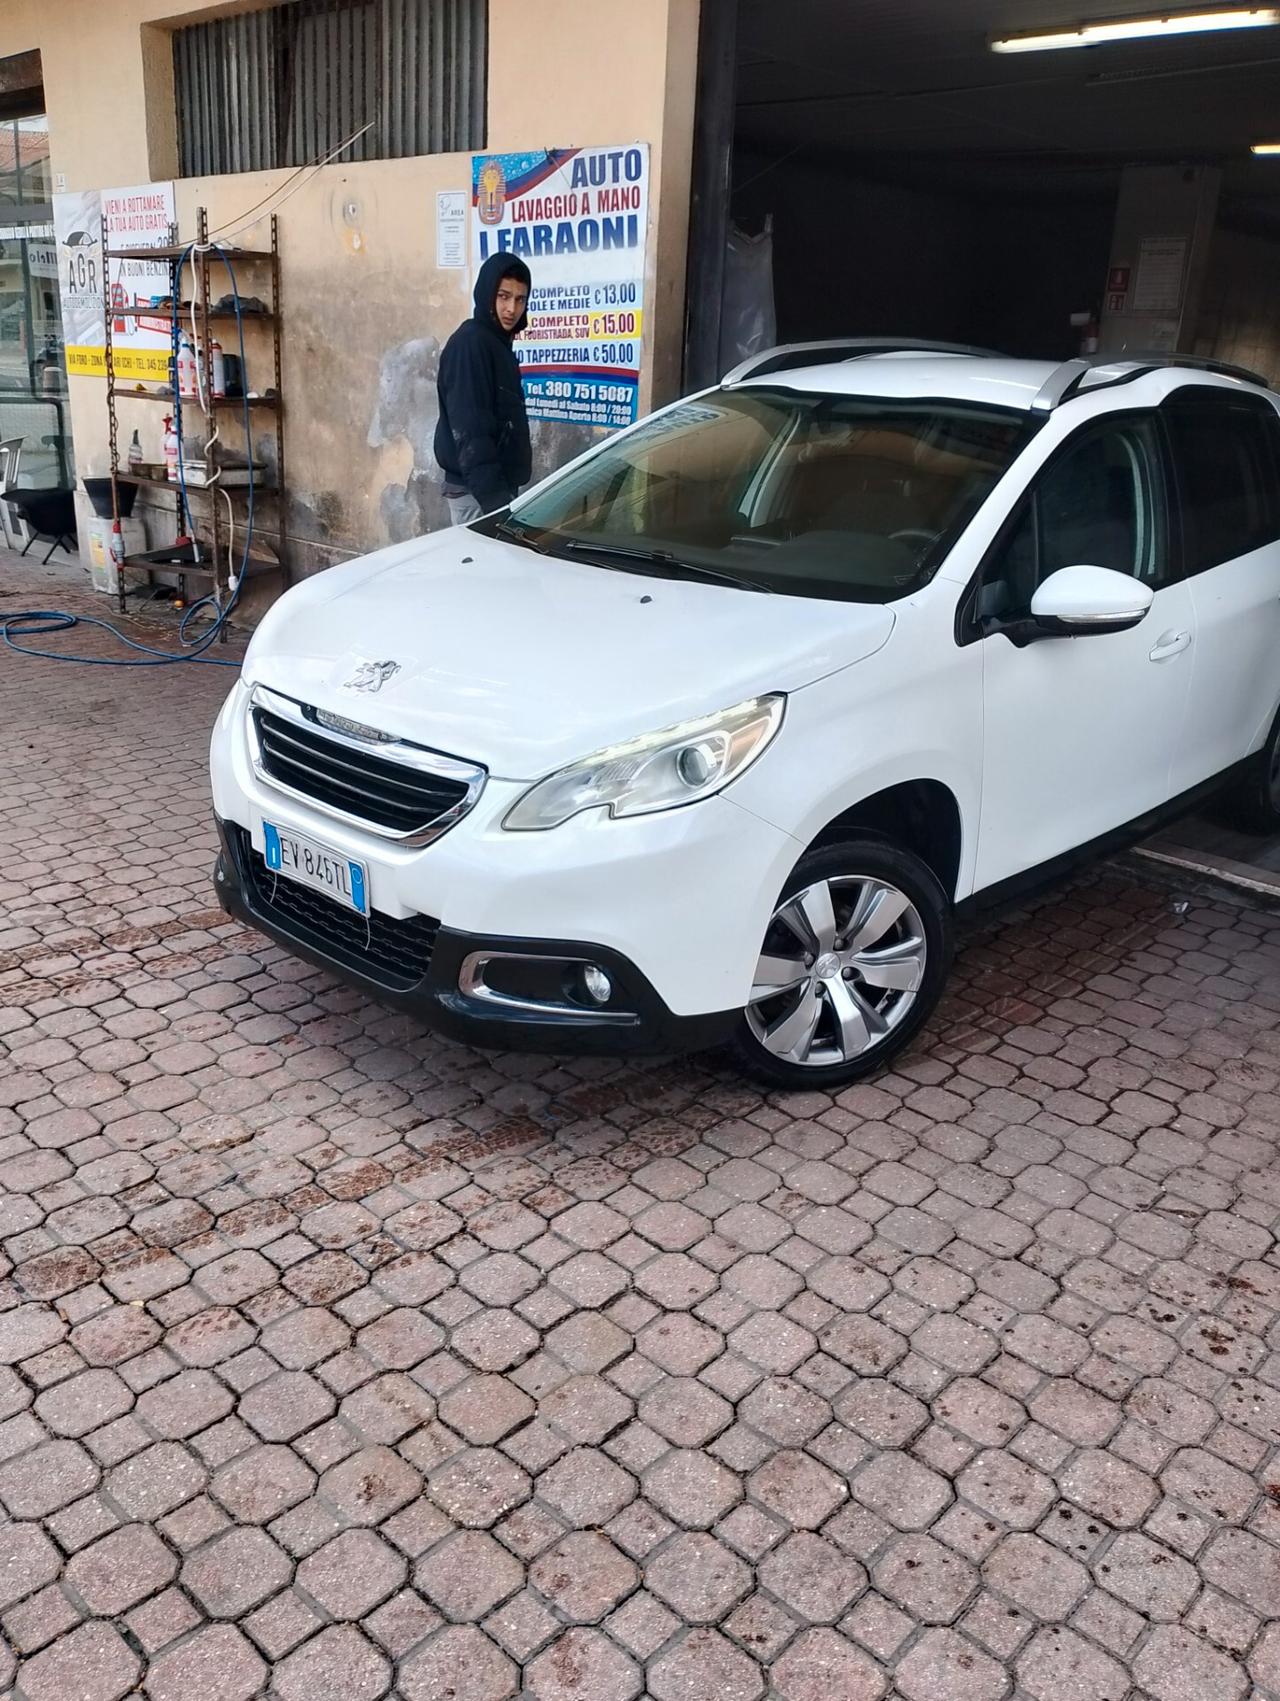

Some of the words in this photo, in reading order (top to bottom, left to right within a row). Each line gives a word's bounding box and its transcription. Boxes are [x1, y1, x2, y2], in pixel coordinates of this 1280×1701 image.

[571, 149, 642, 189] AUTO
[128, 195, 165, 212] ROTTAMARE
[511, 193, 577, 223] LAVAGGIO
[581, 192, 590, 215] A
[598, 185, 641, 213] MANO
[128, 215, 144, 231] AUTO
[145, 213, 168, 230] GRATIS
[479, 231, 489, 260] I
[497, 214, 638, 258] FARAONI
[69, 253, 98, 294] AGR
[146, 262, 169, 277] BENZIN
[532, 285, 590, 299] COMPLETO
[603, 282, 636, 306] 13,00
[550, 299, 556, 311] E
[558, 297, 591, 311] MEDIE
[531, 315, 589, 328] COMPLETO
[602, 313, 635, 335] 15,00
[575, 327, 590, 338] SUV
[526, 347, 590, 363] TAPPEZZERIA
[601, 343, 634, 364] 50,00
[545, 381, 572, 398] 380
[573, 384, 596, 400] 751
[598, 386, 633, 403] 5087
[280, 837, 299, 869] EV
[304, 848, 352, 896] 846TL
